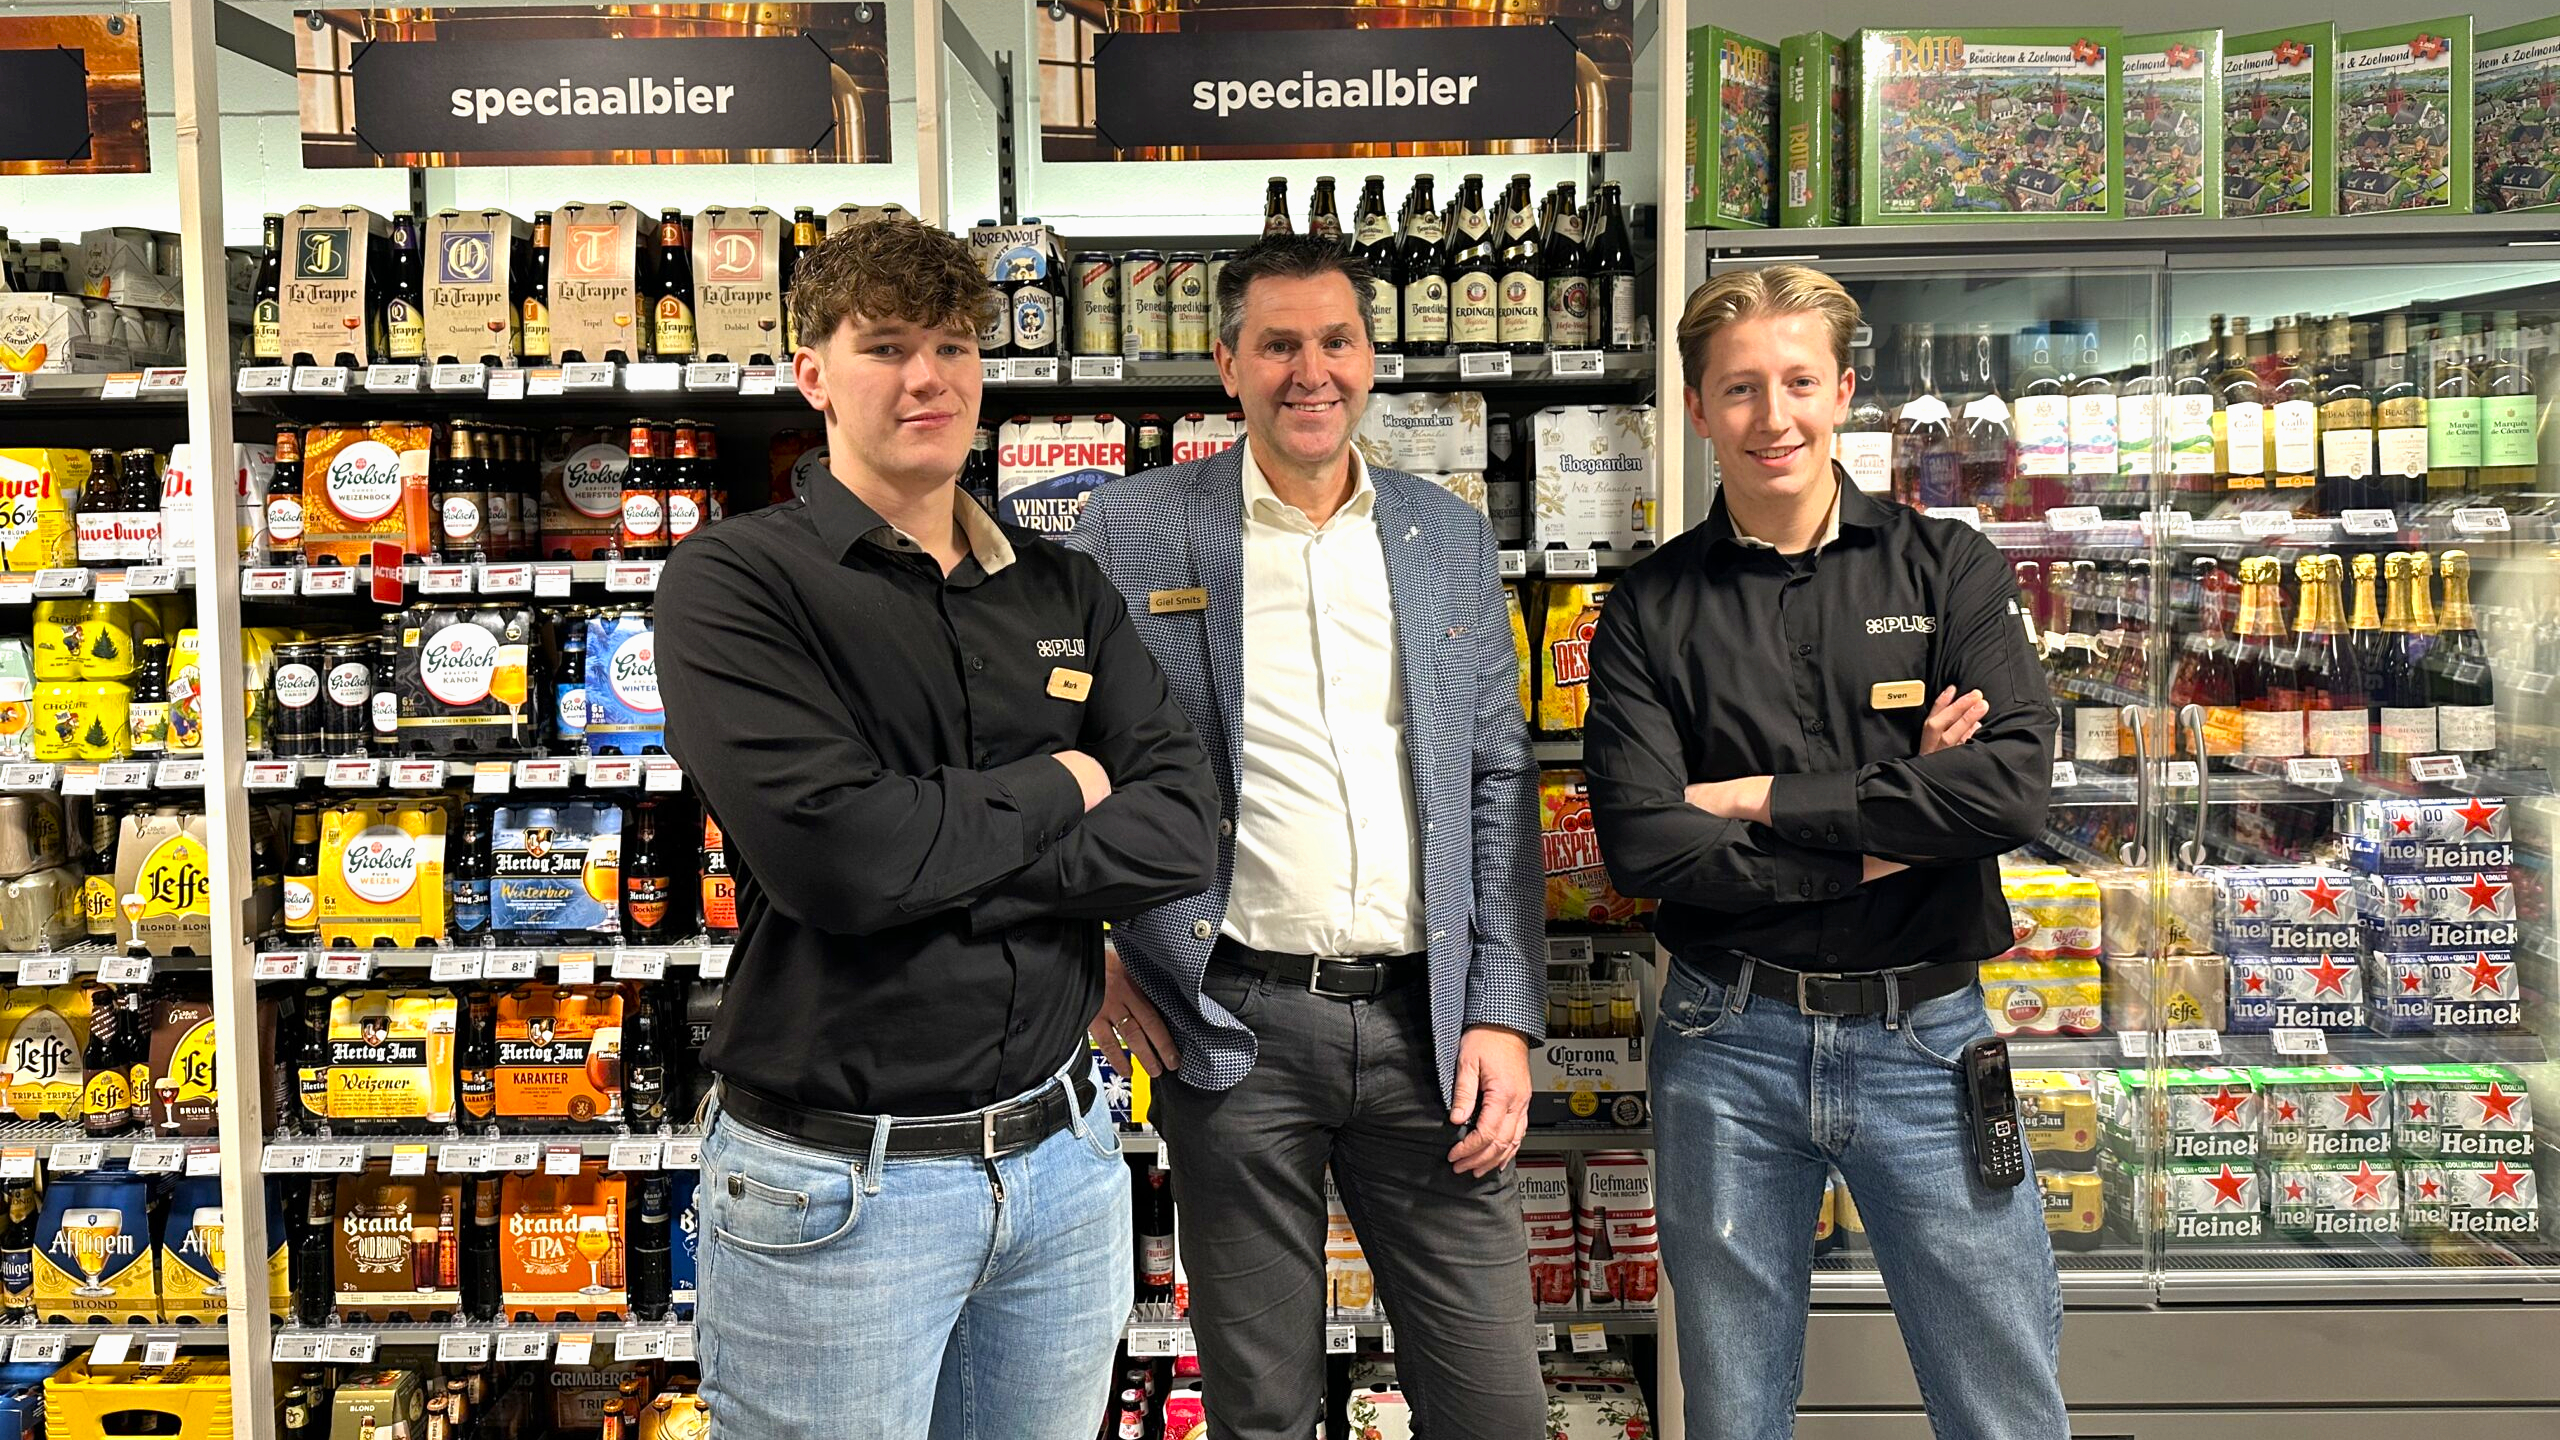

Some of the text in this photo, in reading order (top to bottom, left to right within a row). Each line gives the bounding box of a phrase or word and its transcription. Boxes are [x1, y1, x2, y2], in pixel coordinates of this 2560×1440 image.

[1969, 51, 2016, 64] Beusichem
[2018, 54, 2026, 62] &
[2028, 50, 2072, 63] Zoelmond
[2225, 54, 2274, 73] Zoelmond
[2347, 49, 2410, 68] & Zoelmond
[2501, 53, 2510, 65] &
[1795, 65, 1804, 103] PLUS
[1192, 67, 1478, 118] speciaalbier
[451, 77, 735, 124] speciaalbier
[1892, 199, 1917, 208] PLUS
[972, 227, 1044, 249] KORENWOLF
[714, 234, 756, 274] D
[286, 284, 358, 305] La Trappe
[430, 288, 502, 309] La Trappe
[554, 281, 628, 301] La Trappe
[699, 285, 773, 307] La Trappe
[6, 314, 31, 325] Tripel
[1455, 306, 1495, 318] ERDINGER
[449, 324, 485, 335] Quadrupel
[583, 319, 603, 329] Tripel
[724, 323, 750, 332] Dubbel
[3, 330, 41, 346] Karmeliet
[1022, 333, 1040, 341] WIT
[1383, 414, 1454, 429] Hoegaarden
[2493, 419, 2529, 430] Marqués
[2500, 426, 2530, 436] Cáceres
[1000, 443, 1126, 467] GULPENER
[1560, 454, 1643, 475] Hoegaarden
[331, 462, 400, 490] Grolsch
[1595, 481, 1632, 493] Blanche
[443, 507, 477, 522] Grolsch
[625, 505, 661, 520] Grolsch
[1013, 498, 1079, 516] WINTER
[269, 509, 303, 524] Grolsch
[374, 566, 396, 578] ACTIE
[1155, 596, 1201, 607] Giel Smits
[1883, 615, 1936, 633] PLUS
[426, 645, 498, 675] Grolsch
[277, 676, 317, 692] Grolsch
[330, 676, 370, 691] Grolsch
[1063, 680, 1077, 689] Mark
[402, 696, 415, 706] 6x
[1887, 692, 1907, 700] Sven
[591, 703, 604, 713] 6x
[348, 846, 416, 874] Grolsch
[495, 853, 581, 875] Hertog Jan
[147, 863, 209, 910] Leffe
[360, 877, 400, 885] WEIZEN
[501, 882, 574, 900] Winterbier
[629, 891, 655, 901] Hertog
[324, 896, 336, 905] 6x
[633, 904, 664, 914] Bockbier
[140, 923, 177, 932] BLONDE
[2052, 929, 2089, 941] Radler
[2010, 999, 2039, 1007] AMSTEL
[2059, 1009, 2095, 1021] Radler
[1631, 1039, 1638, 1048] 6
[15, 1034, 73, 1080] Leffe
[332, 1042, 417, 1064] Hertog Jan
[499, 1043, 584, 1065] Hertog Jan
[1547, 1045, 1618, 1068] Corona
[513, 1072, 568, 1084] KARAKTER
[1566, 1064, 1603, 1077] Extra
[339, 1073, 410, 1093] Weizener
[46, 1091, 77, 1099] TRIPEL
[90, 1084, 125, 1109] Leffe
[180, 1107, 211, 1115] BRUNE
[2041, 1116, 2061, 1126] Jan
[1589, 1172, 1649, 1197] Liefmans
[1538, 1192, 1557, 1200] ROCKS
[1620, 1190, 1640, 1198] ROCKS
[2048, 1196, 2069, 1207] Jan
[343, 1212, 413, 1236] Brand
[509, 1212, 579, 1236] Brand
[48, 1229, 136, 1257] Affligem
[358, 1237, 402, 1259] OUD BRUIN
[531, 1237, 564, 1259] IPA
[72, 1299, 119, 1310] BLOND
[550, 1371, 637, 1387] GRIMBERG
